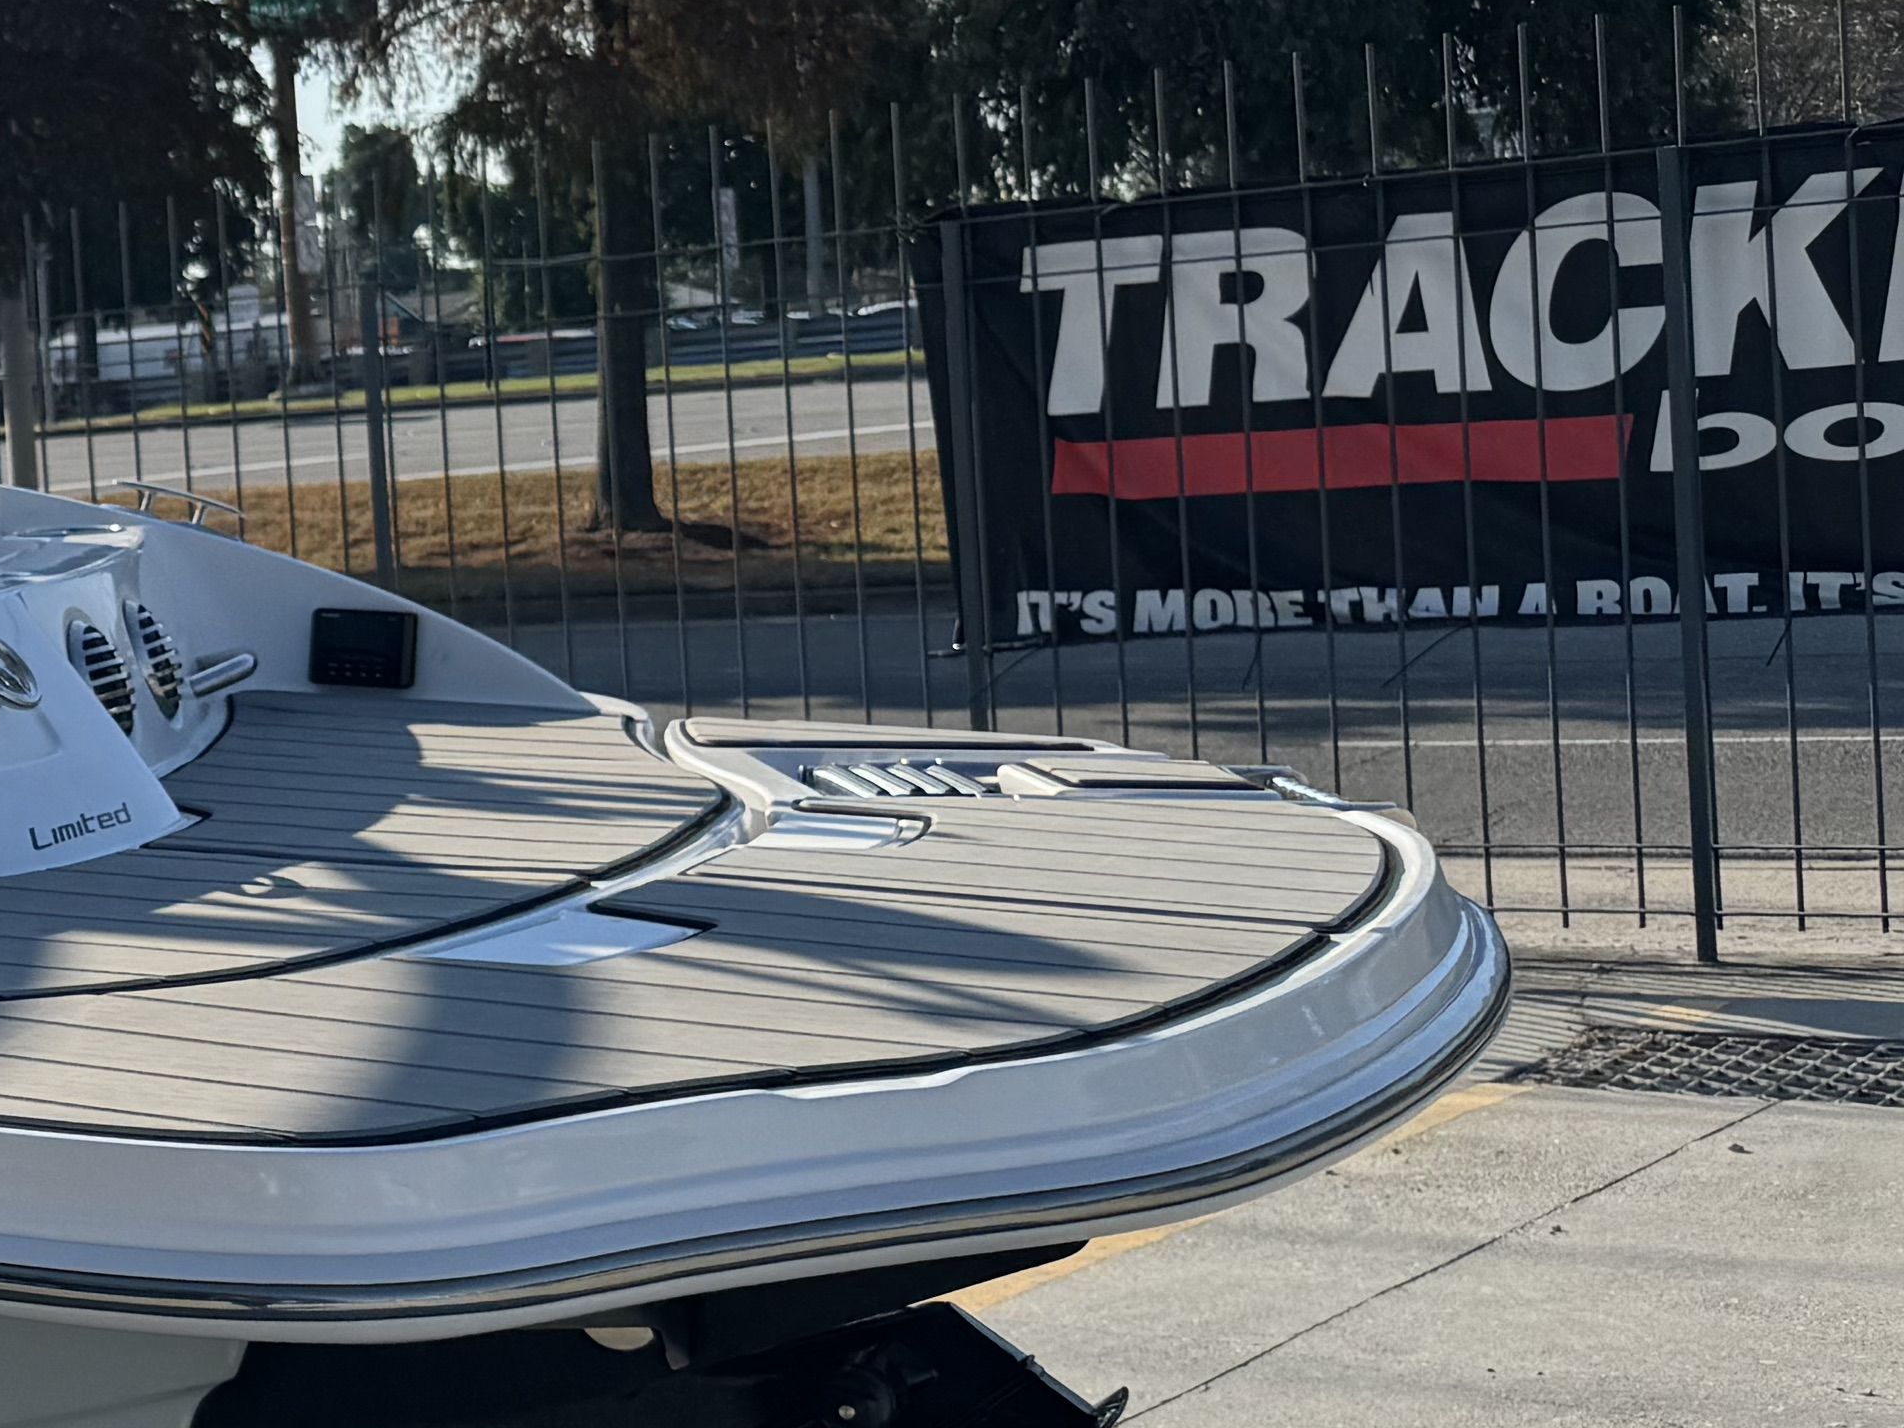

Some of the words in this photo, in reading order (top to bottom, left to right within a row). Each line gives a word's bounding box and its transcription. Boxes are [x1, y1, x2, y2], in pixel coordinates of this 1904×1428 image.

[1020, 166, 1904, 416] TRACK
[1017, 588, 1117, 636] IT'S
[1133, 587, 1314, 633] MORE
[1317, 584, 1500, 624] THAN
[1517, 581, 1557, 615] A
[1788, 571, 1904, 612] IT'S
[28, 801, 132, 851] Limited
